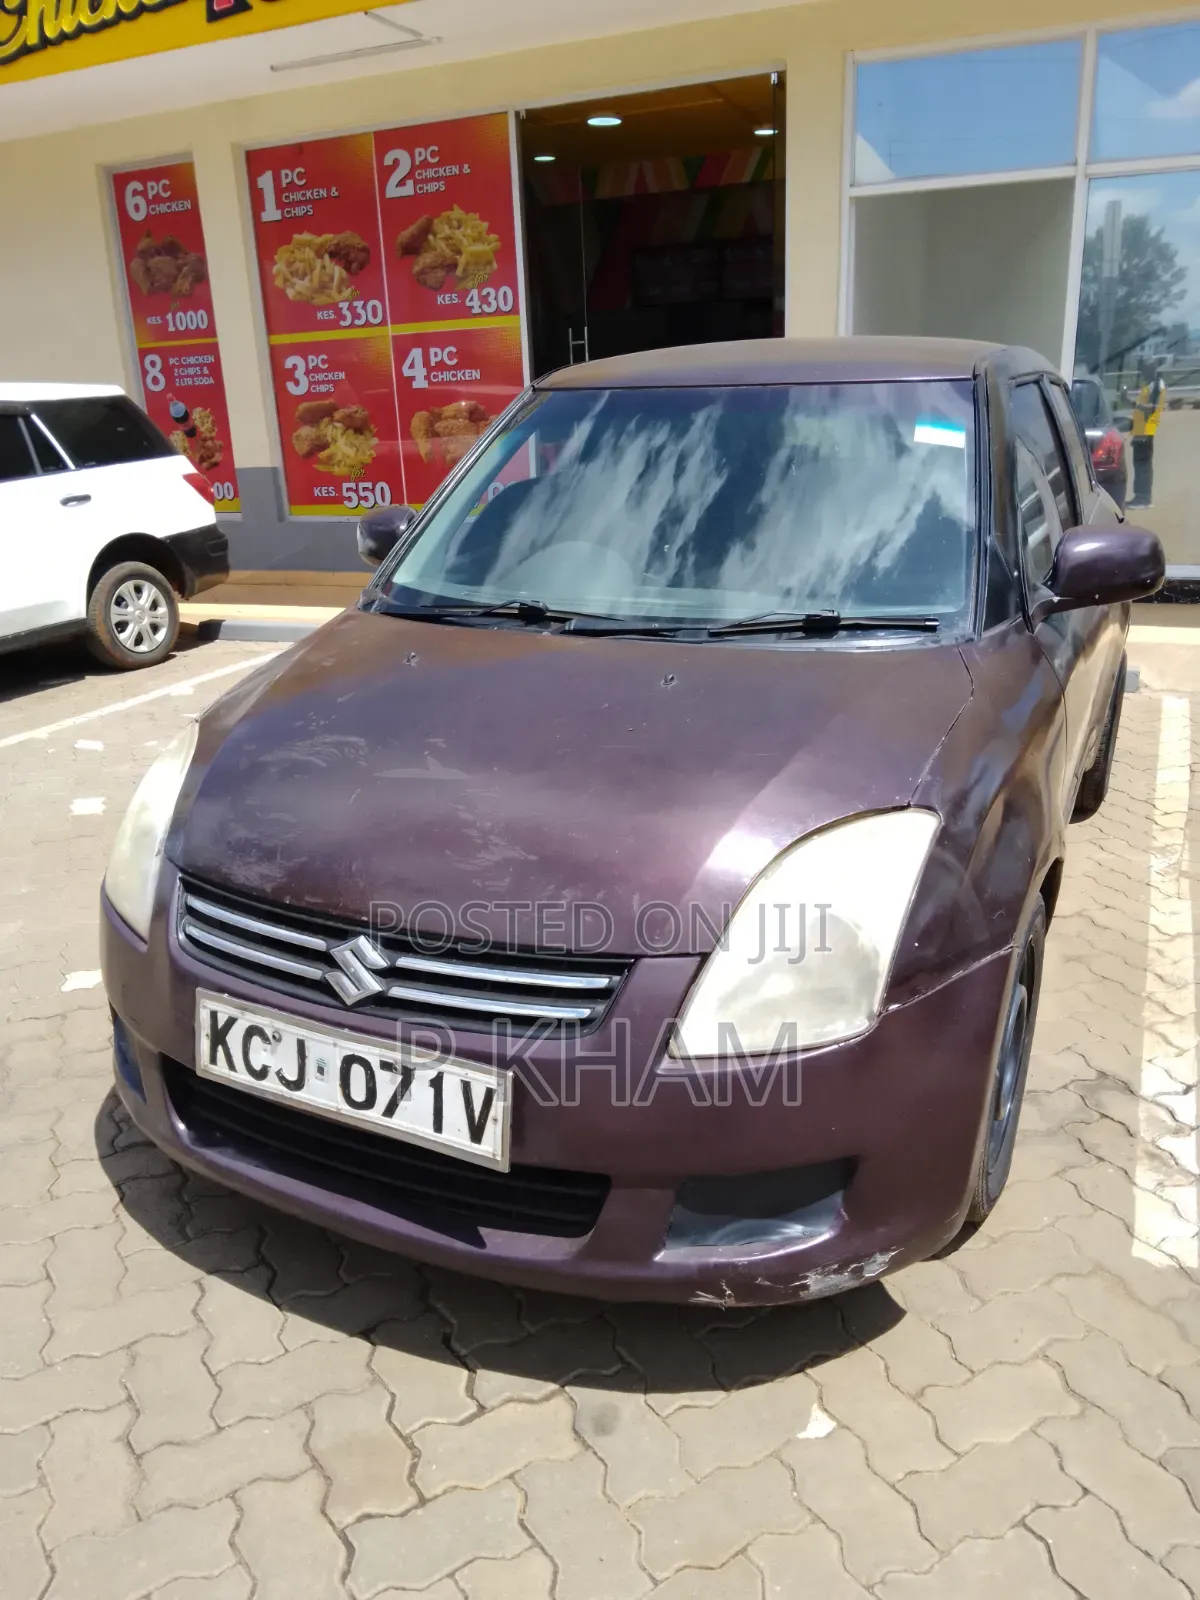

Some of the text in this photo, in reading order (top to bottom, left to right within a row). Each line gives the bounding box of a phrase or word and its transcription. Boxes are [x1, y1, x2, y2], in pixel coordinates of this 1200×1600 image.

[383, 145, 440, 199] 2 PC
[415, 163, 471, 180] CHICKEN &
[257, 167, 307, 222] 1 PC
[282, 186, 339, 204] CHICKEN &
[416, 181, 446, 195] CHIPS
[125, 178, 171, 222] 6 PC
[148, 199, 192, 215] CHICKEN
[284, 204, 314, 218] CHIPS
[437, 286, 514, 314] KES. 430
[166, 309, 208, 332] 1000
[317, 299, 383, 327] KES. 330
[144, 354, 215, 392] 8 PC CHICKEN
[174, 368, 179, 377] 2
[179, 367, 201, 376] CHIPS
[284, 354, 329, 396] 3 PC
[309, 371, 346, 382] CHICKEN
[402, 346, 458, 389] 4 PC
[430, 368, 481, 382] CHICKEN
[175, 376, 215, 387] 2 LTR SODA
[310, 383, 335, 393] CHIPS
[350, 465, 366, 482] for
[314, 481, 392, 509] KES. 550
[209, 1010, 498, 1146] KCJ 071V
